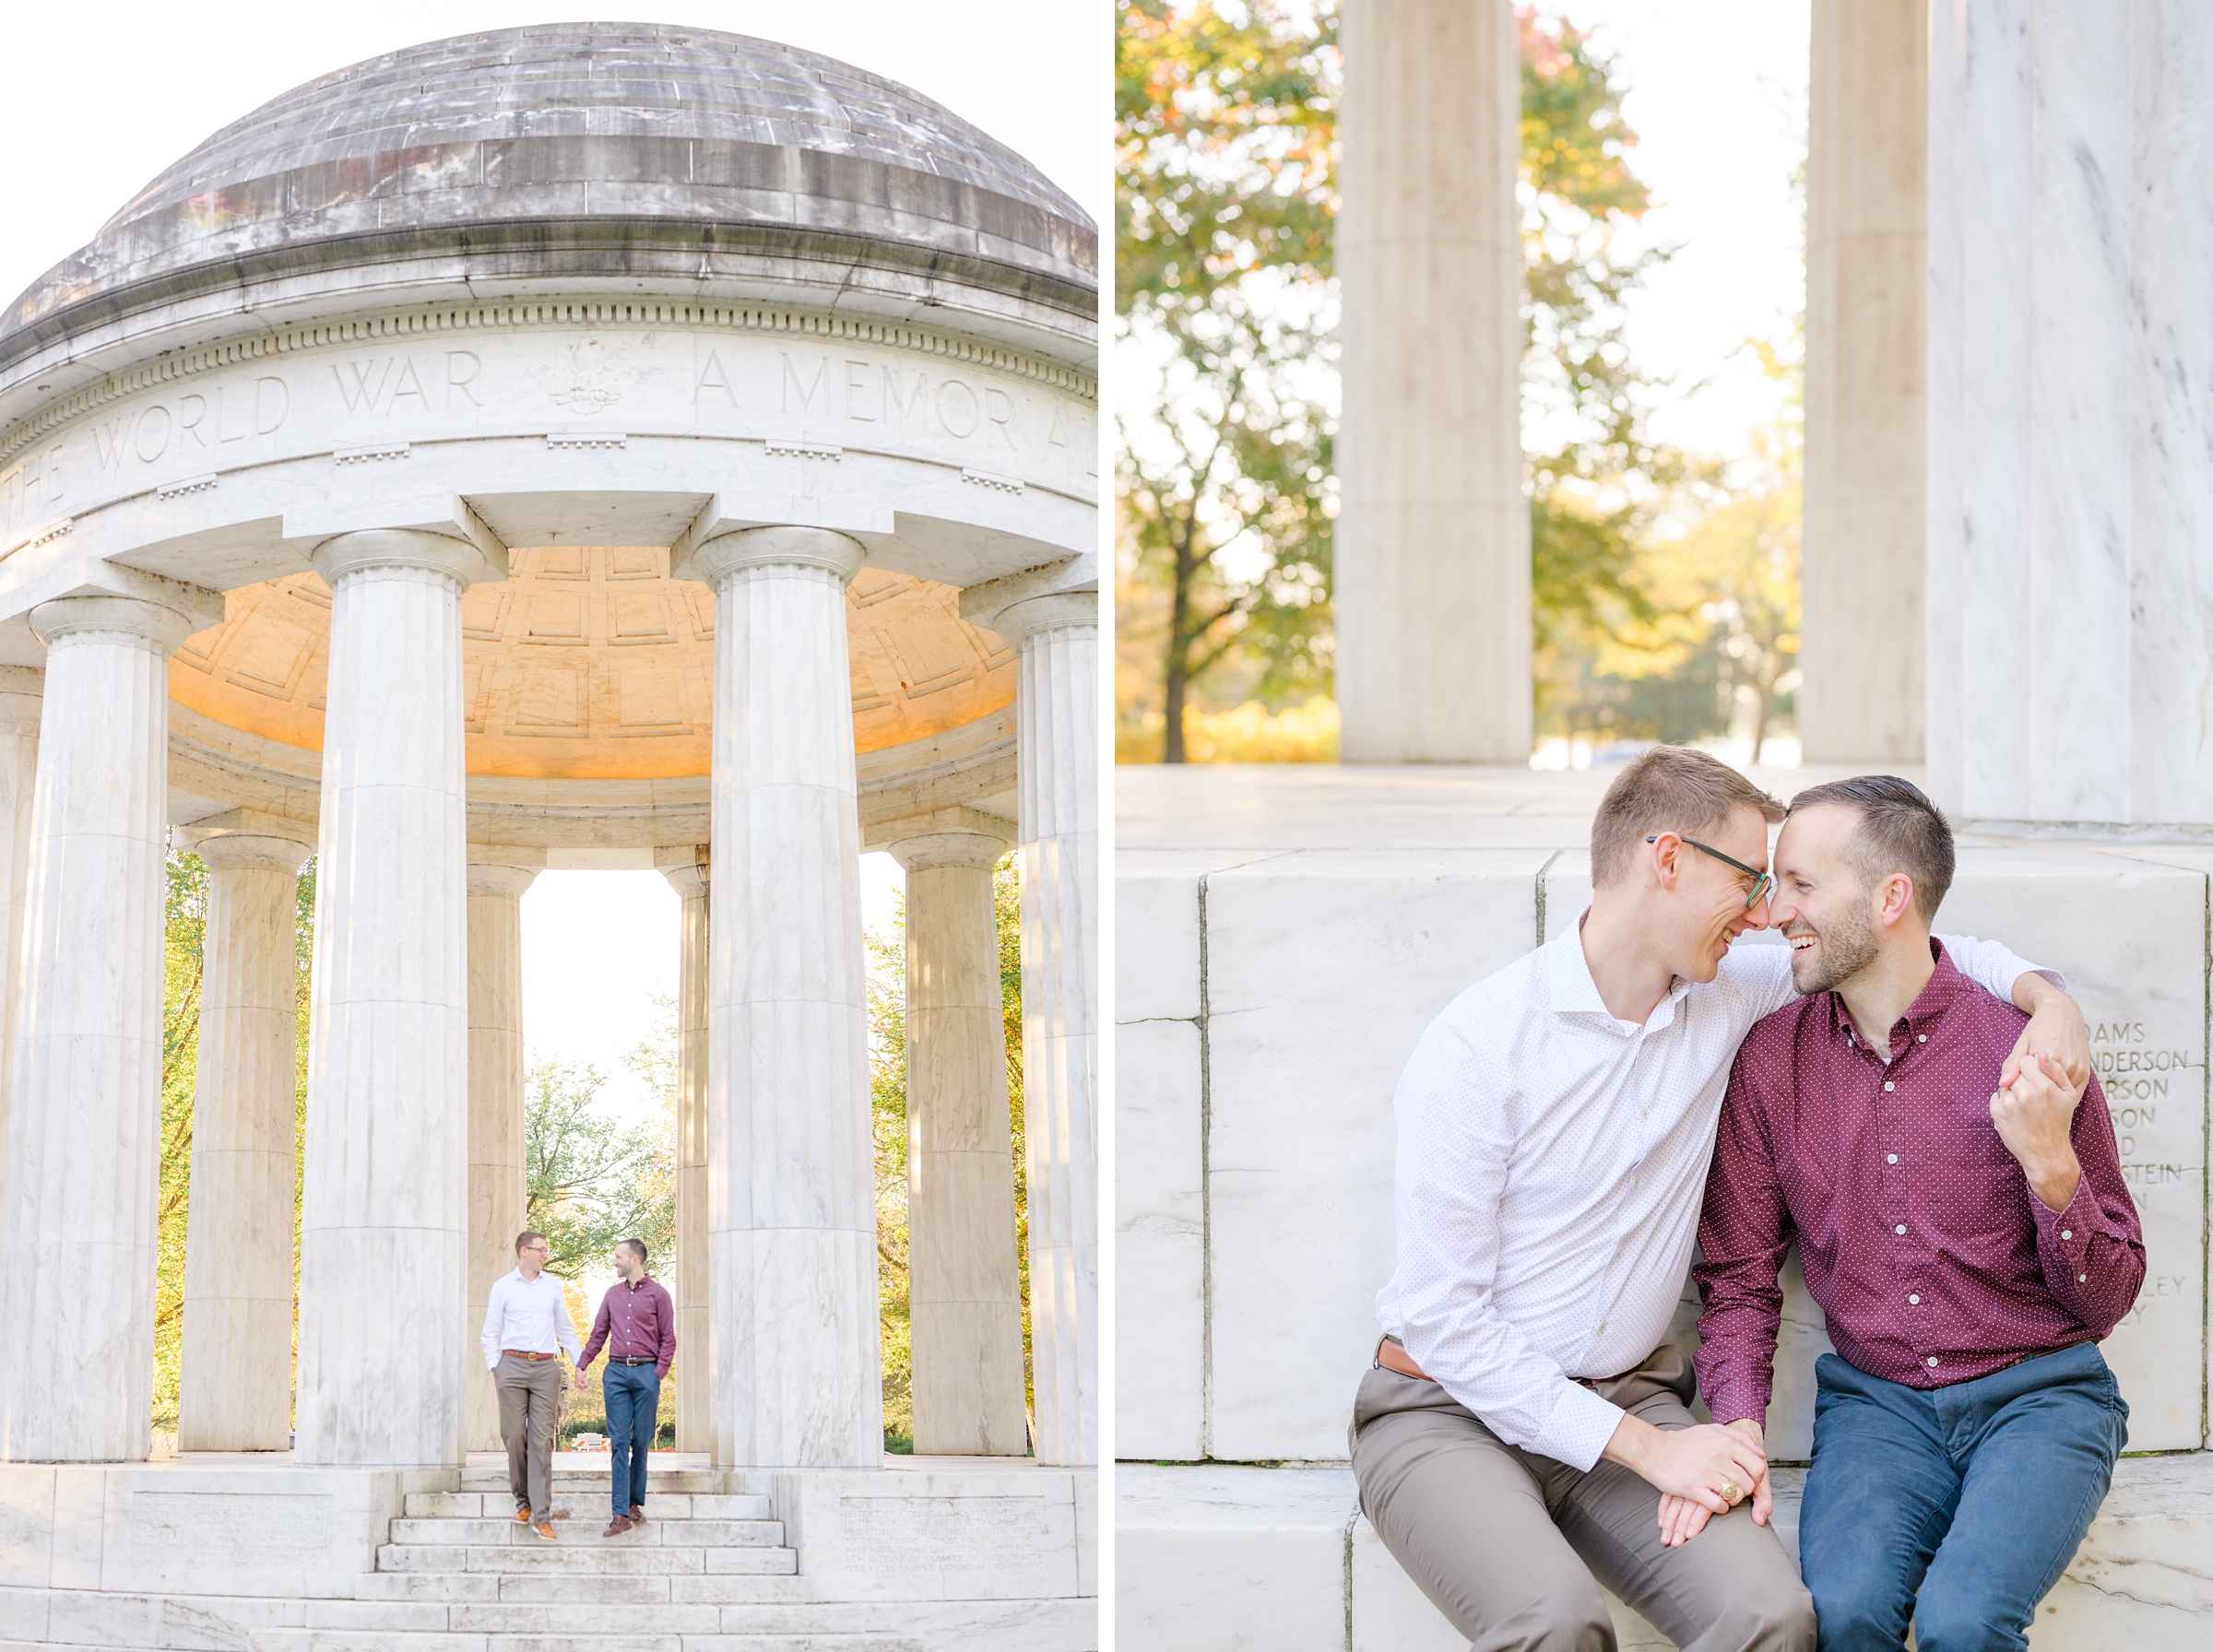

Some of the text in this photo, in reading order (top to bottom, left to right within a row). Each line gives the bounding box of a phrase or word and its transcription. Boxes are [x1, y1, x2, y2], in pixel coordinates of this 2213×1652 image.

[4, 443, 65, 531] THE
[91, 375, 291, 478] WORLD
[328, 349, 487, 419] WAR
[690, 347, 740, 408] A
